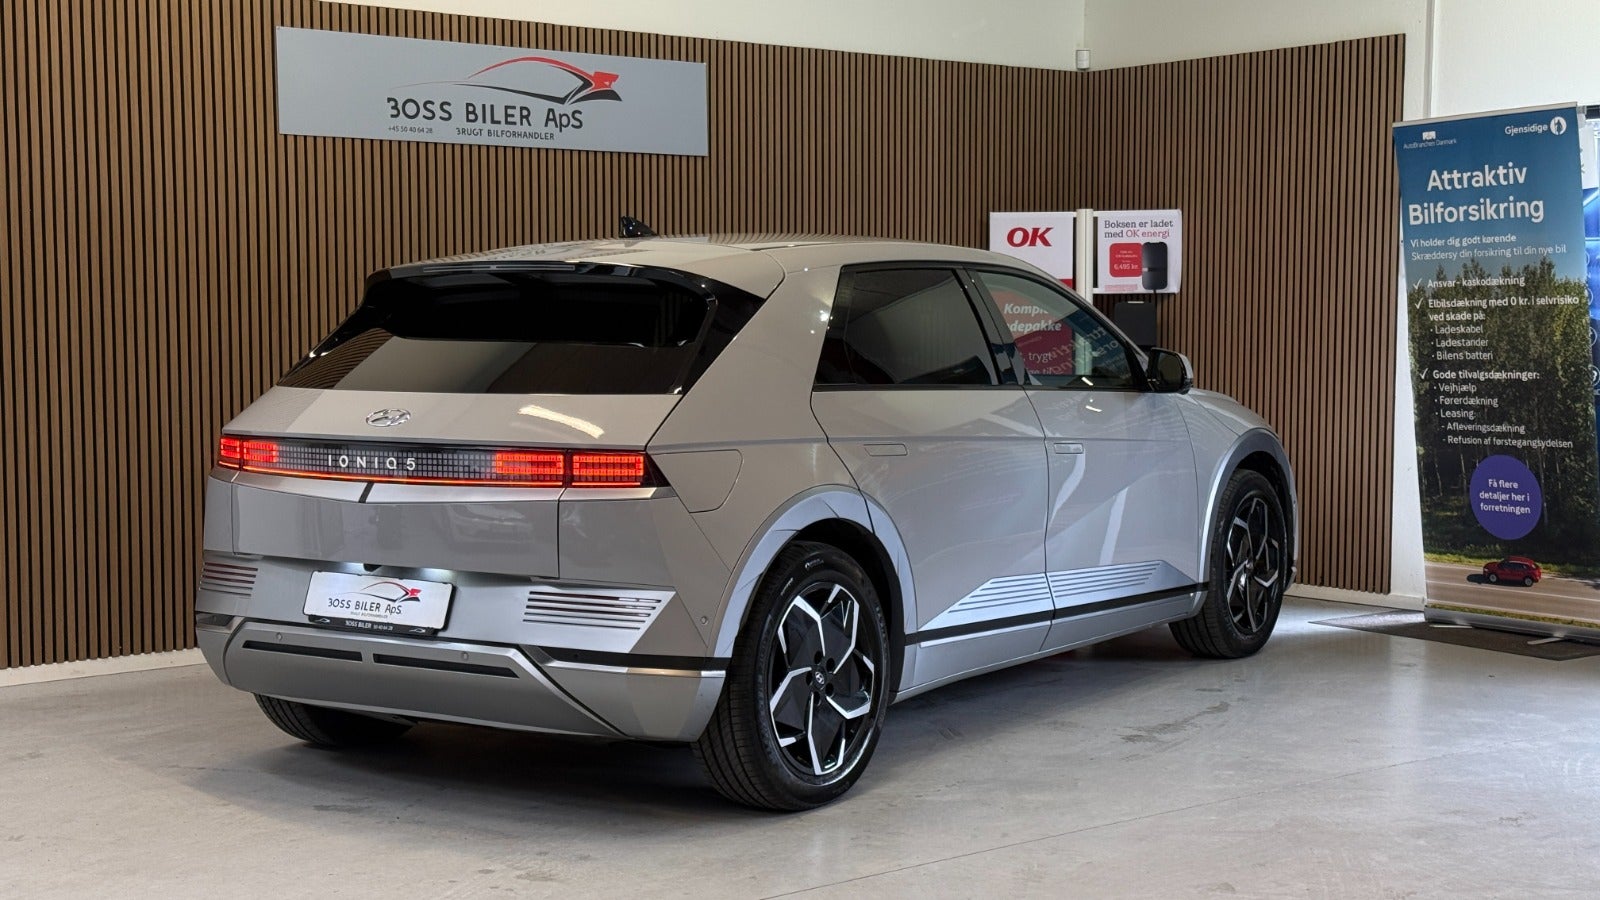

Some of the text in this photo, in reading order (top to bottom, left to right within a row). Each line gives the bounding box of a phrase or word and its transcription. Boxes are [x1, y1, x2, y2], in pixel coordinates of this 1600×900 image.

[465, 102, 532, 126] BILER
[544, 108, 584, 132] ApS
[487, 129, 555, 140] BILFORHANDLER
[1504, 123, 1548, 136] Gjensidige
[1427, 162, 1528, 191] Attraktiv
[1408, 196, 1545, 226] Bilforsikring
[1104, 220, 1137, 229] Boksen
[1150, 219, 1174, 228] ladet
[1006, 227, 1054, 247] OK
[1104, 229, 1170, 239] med OK energi
[1410, 233, 1517, 248] Vi holder dig godt kørende
[1411, 244, 1567, 261] Skræddersy din forsikring til din nye bil
[1462, 276, 1526, 287] kaskodækning
[1428, 298, 1488, 309] Elbilsdækning
[1488, 297, 1509, 307] med
[1510, 296, 1517, 305] 0
[1518, 296, 1531, 305] kr.
[1536, 294, 1580, 305] selvrisiko
[1429, 311, 1486, 322] ved skade på:
[1008, 320, 1062, 334] depakke
[1434, 325, 1484, 334] Ladeskabel
[1435, 338, 1489, 348] Ladestander
[1028, 352, 1052, 363] trygt
[1436, 351, 1494, 361] Bilens batteri
[1432, 369, 1541, 382] Gode tilvalgsdækninger:
[1438, 383, 1477, 394] Vejhjælp
[1439, 395, 1499, 407] Førerdækning
[1446, 423, 1526, 435] Afleveringsdækning
[1447, 435, 1574, 449] Refusion af førstegangsydelsen
[328, 454, 416, 471] IONIQ 5
[1488, 479, 1519, 489] Få flere
[1479, 491, 1510, 502] detaljer
[1511, 493, 1526, 502] her
[1480, 502, 1531, 515] forretningen
[354, 600, 380, 612] BILER
[384, 605, 403, 615] ApS
